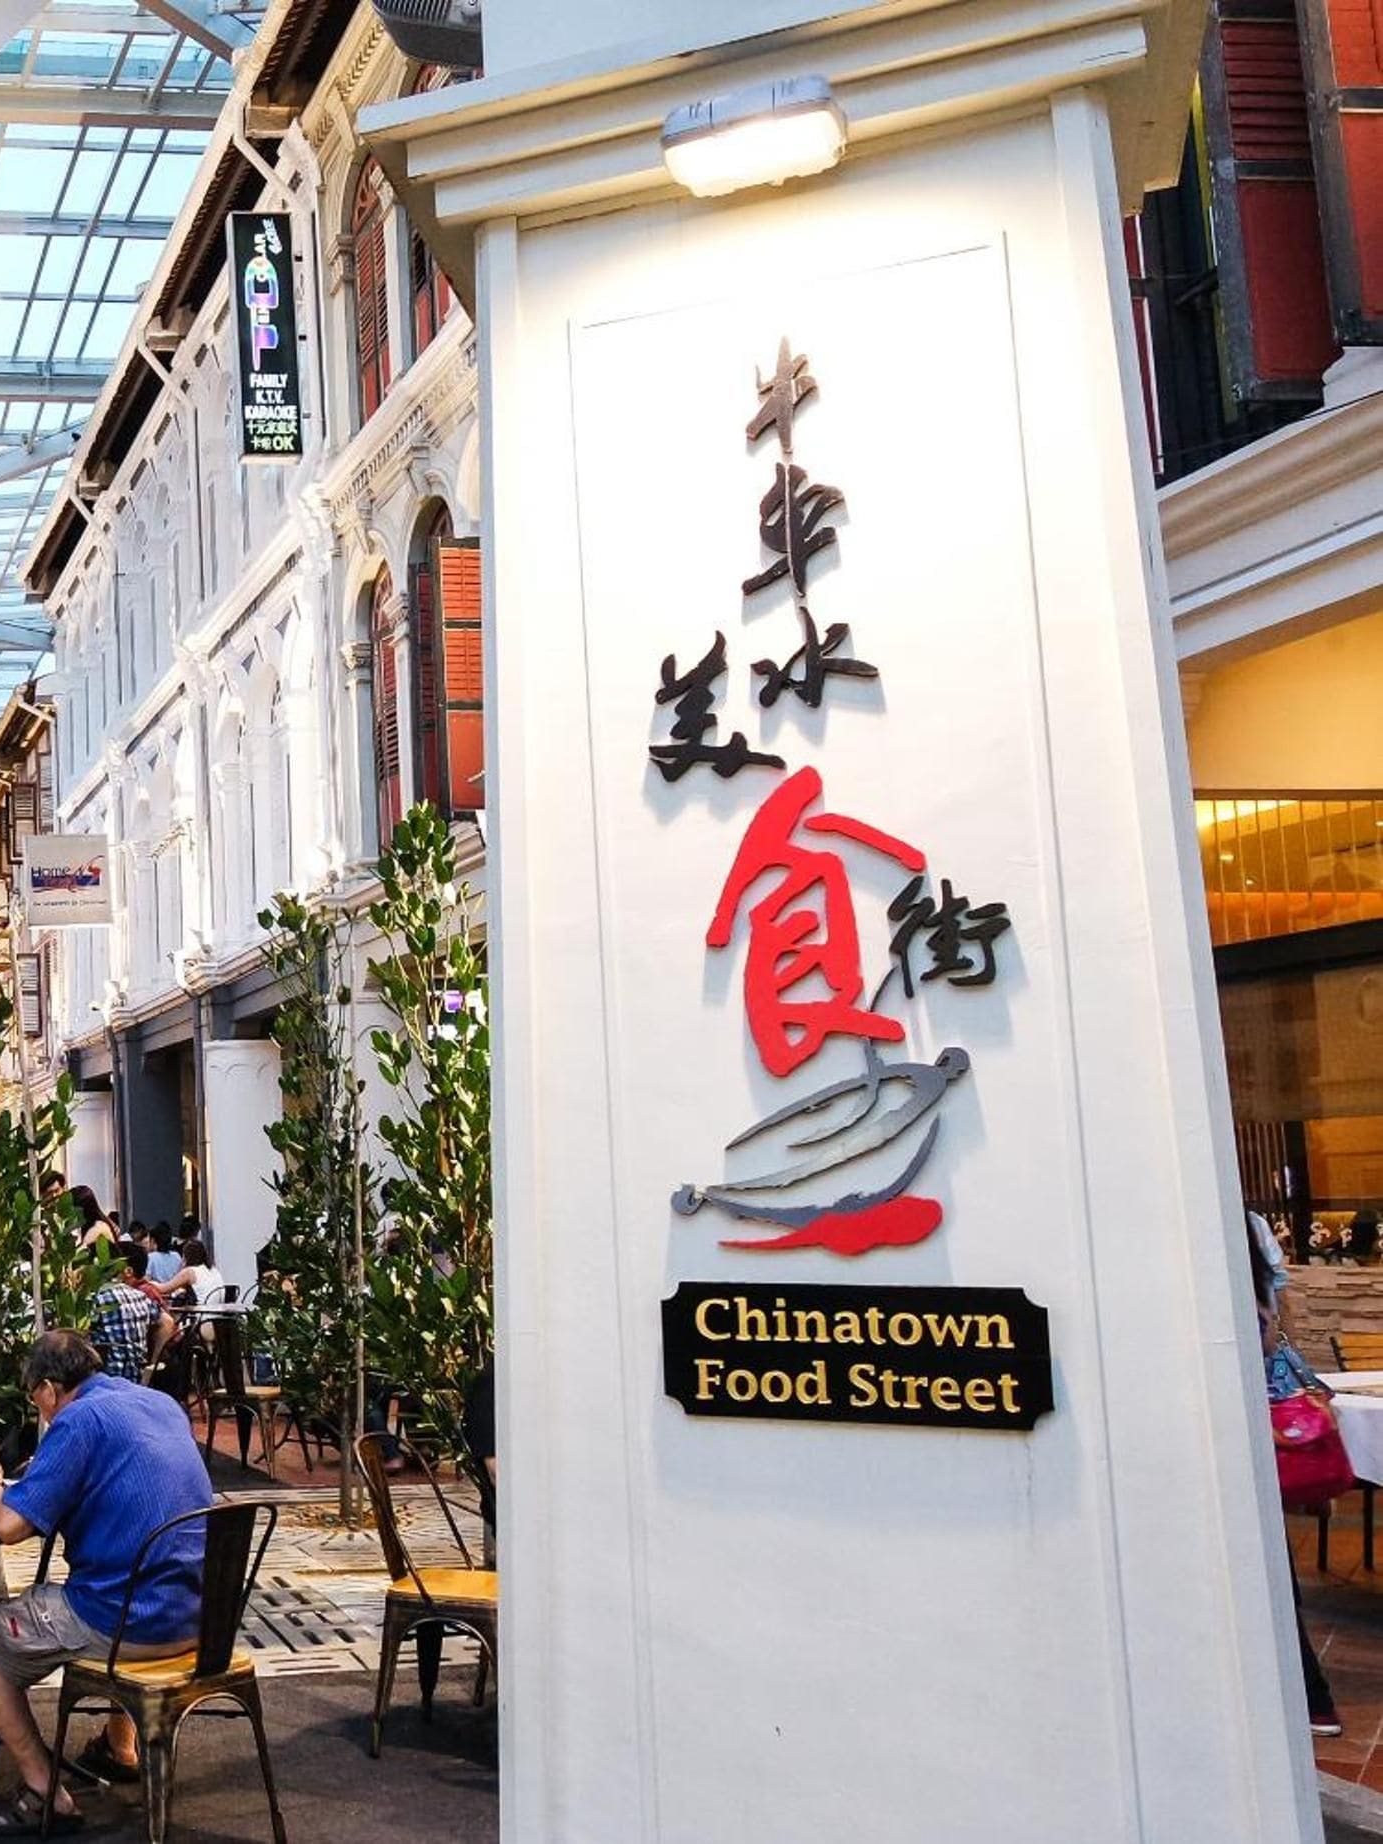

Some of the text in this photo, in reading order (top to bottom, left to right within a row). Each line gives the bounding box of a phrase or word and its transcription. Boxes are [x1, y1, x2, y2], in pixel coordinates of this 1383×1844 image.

[249, 373, 288, 388] FAMILY
[245, 405, 298, 420] KARAOKE
[694, 1297, 1015, 1349] Chinatown
[693, 1358, 1021, 1414] Food Street
